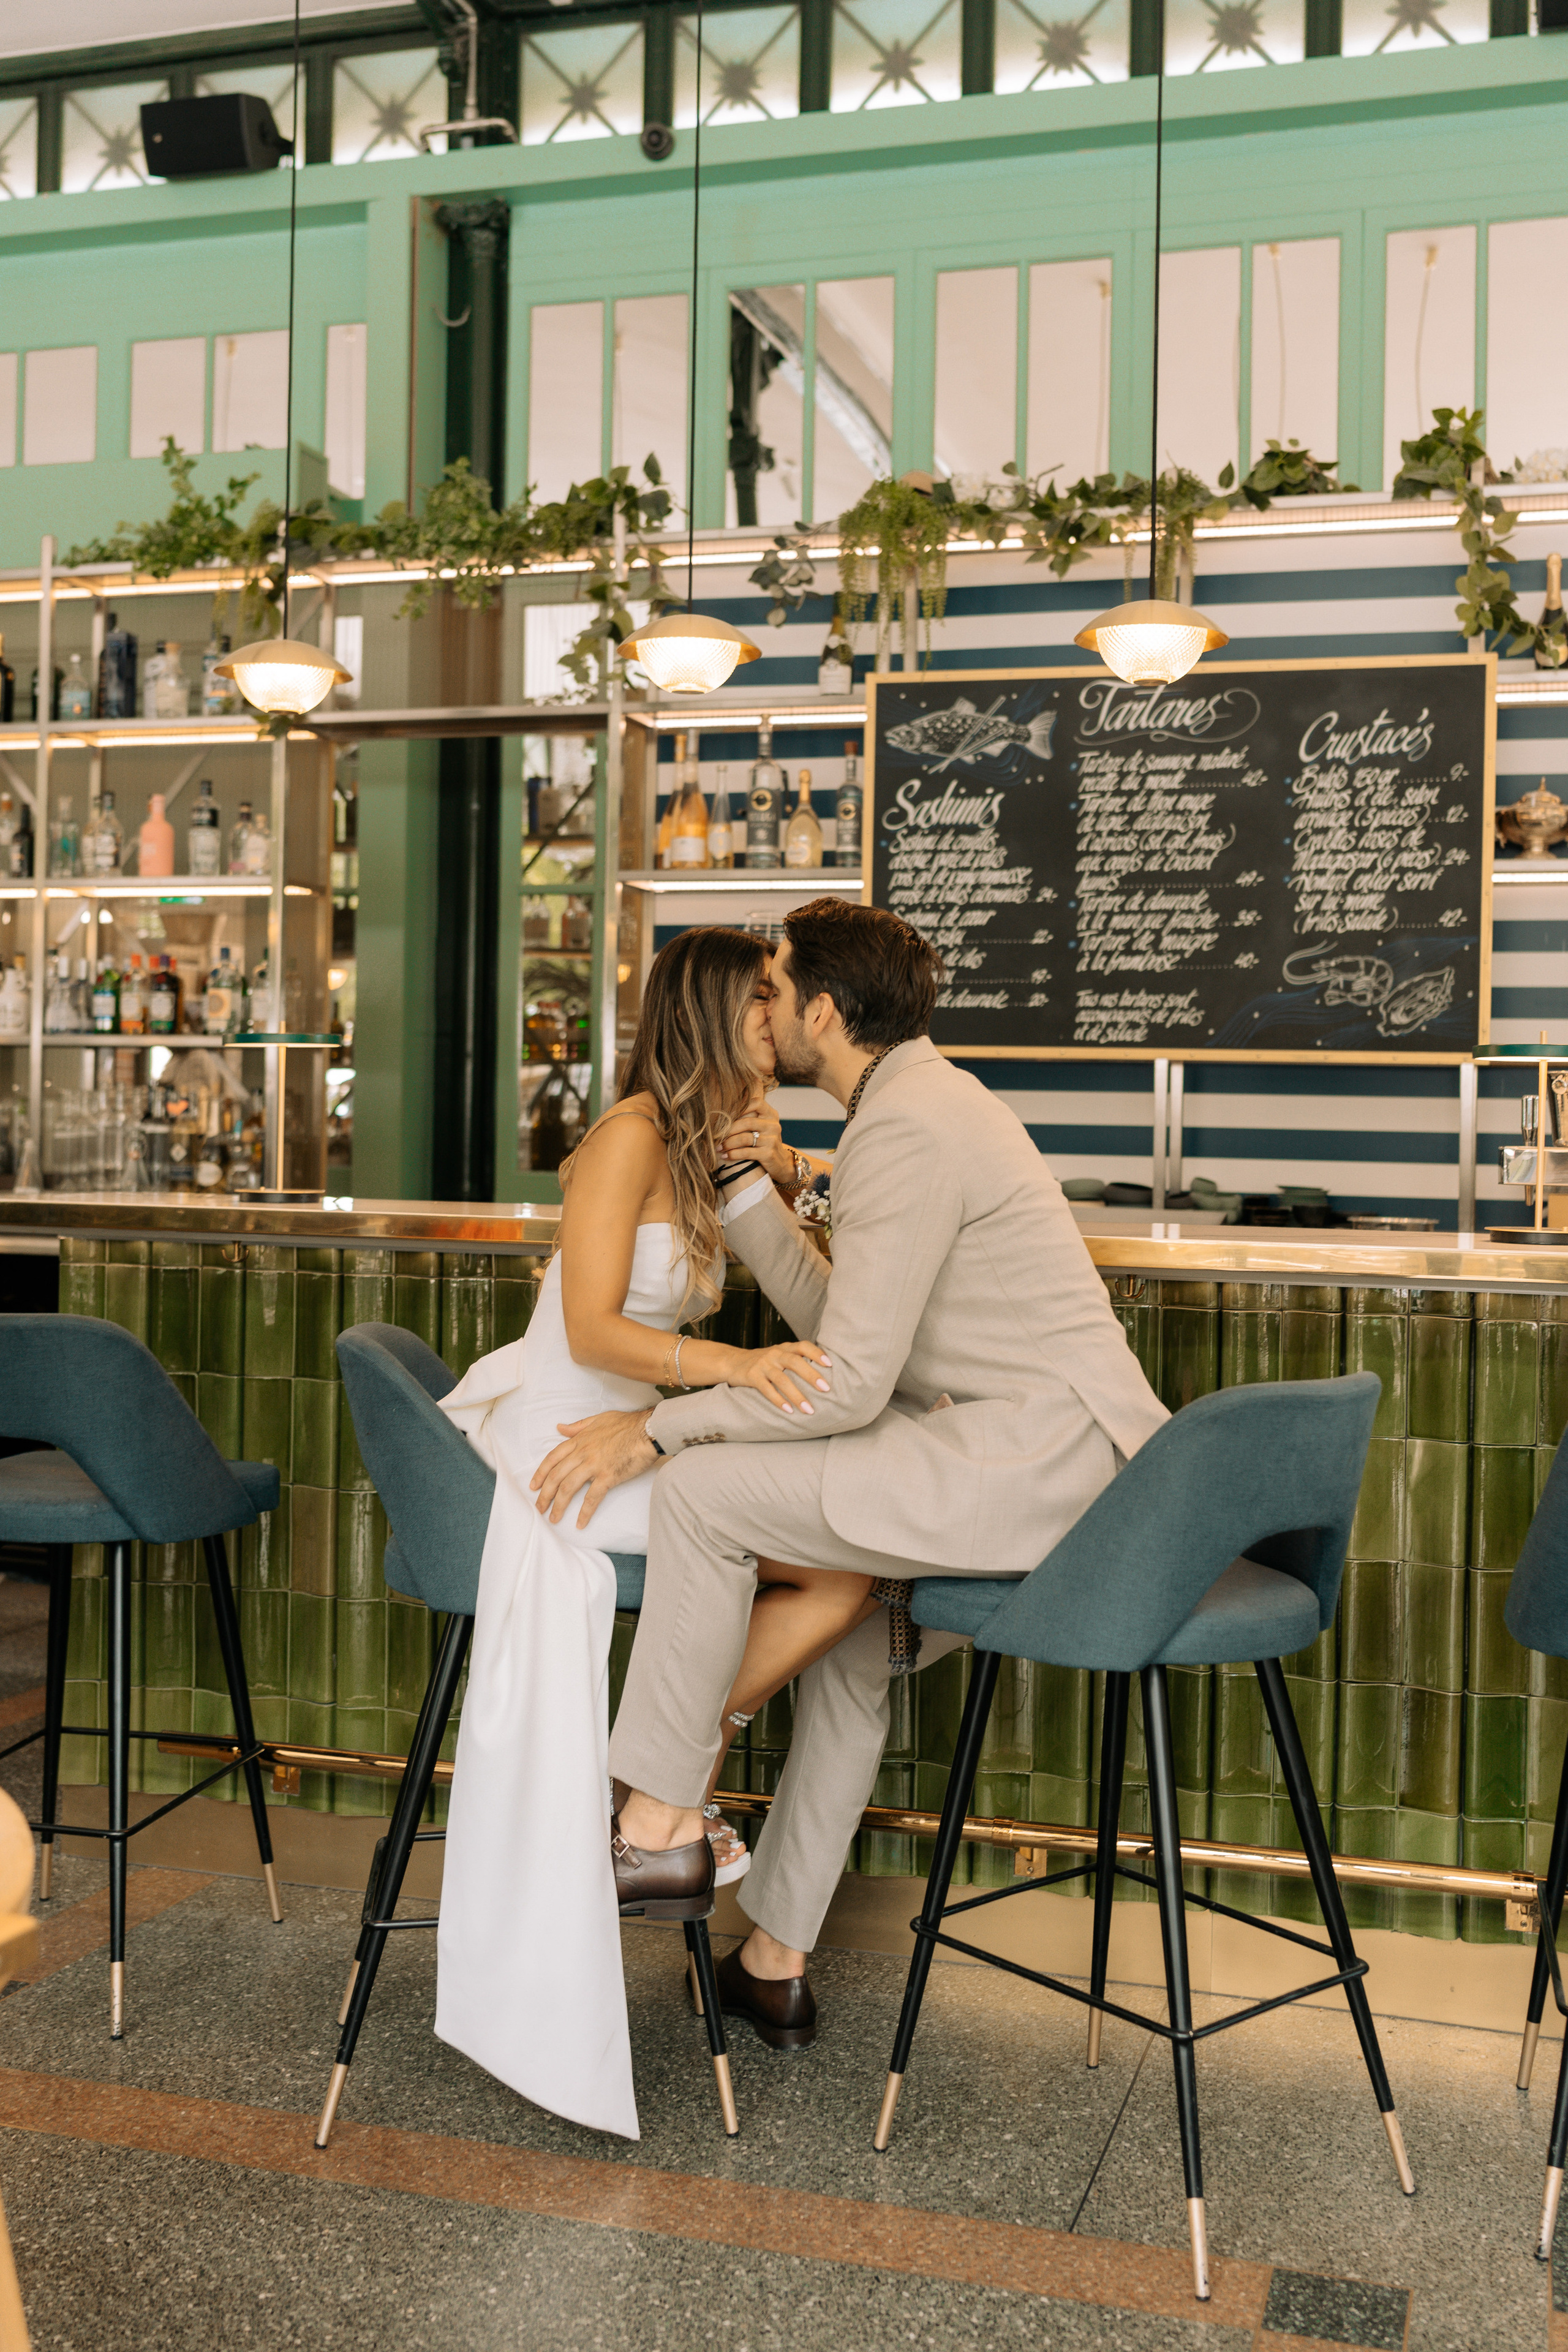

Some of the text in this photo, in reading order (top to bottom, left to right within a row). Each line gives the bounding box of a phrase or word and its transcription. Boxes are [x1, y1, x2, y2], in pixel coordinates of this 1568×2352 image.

[1079, 679, 1223, 735] Tartares
[1298, 707, 1434, 765] Crustacés
[1078, 750, 1126, 776] Tartare
[1123, 748, 1143, 772] de
[1140, 754, 1196, 774] saumon
[881, 778, 1005, 831] Sashimis
[1078, 790, 1217, 817] Tartare de thon rouge
[1401, 783, 1440, 807] selon
[1077, 812, 1096, 834] de
[1401, 826, 1427, 848] de
[1144, 851, 1165, 872] de
[1077, 888, 1209, 916] Tartare de daurade
[940, 905, 960, 927] de
[1091, 910, 1107, 930] la
[1108, 913, 1167, 938] mangue
[1077, 929, 1219, 959] Tartare de maigre
[944, 947, 962, 967] de
[1090, 950, 1108, 970] la
[949, 988, 1009, 1009] daurade
[1151, 1008, 1170, 1023] de
